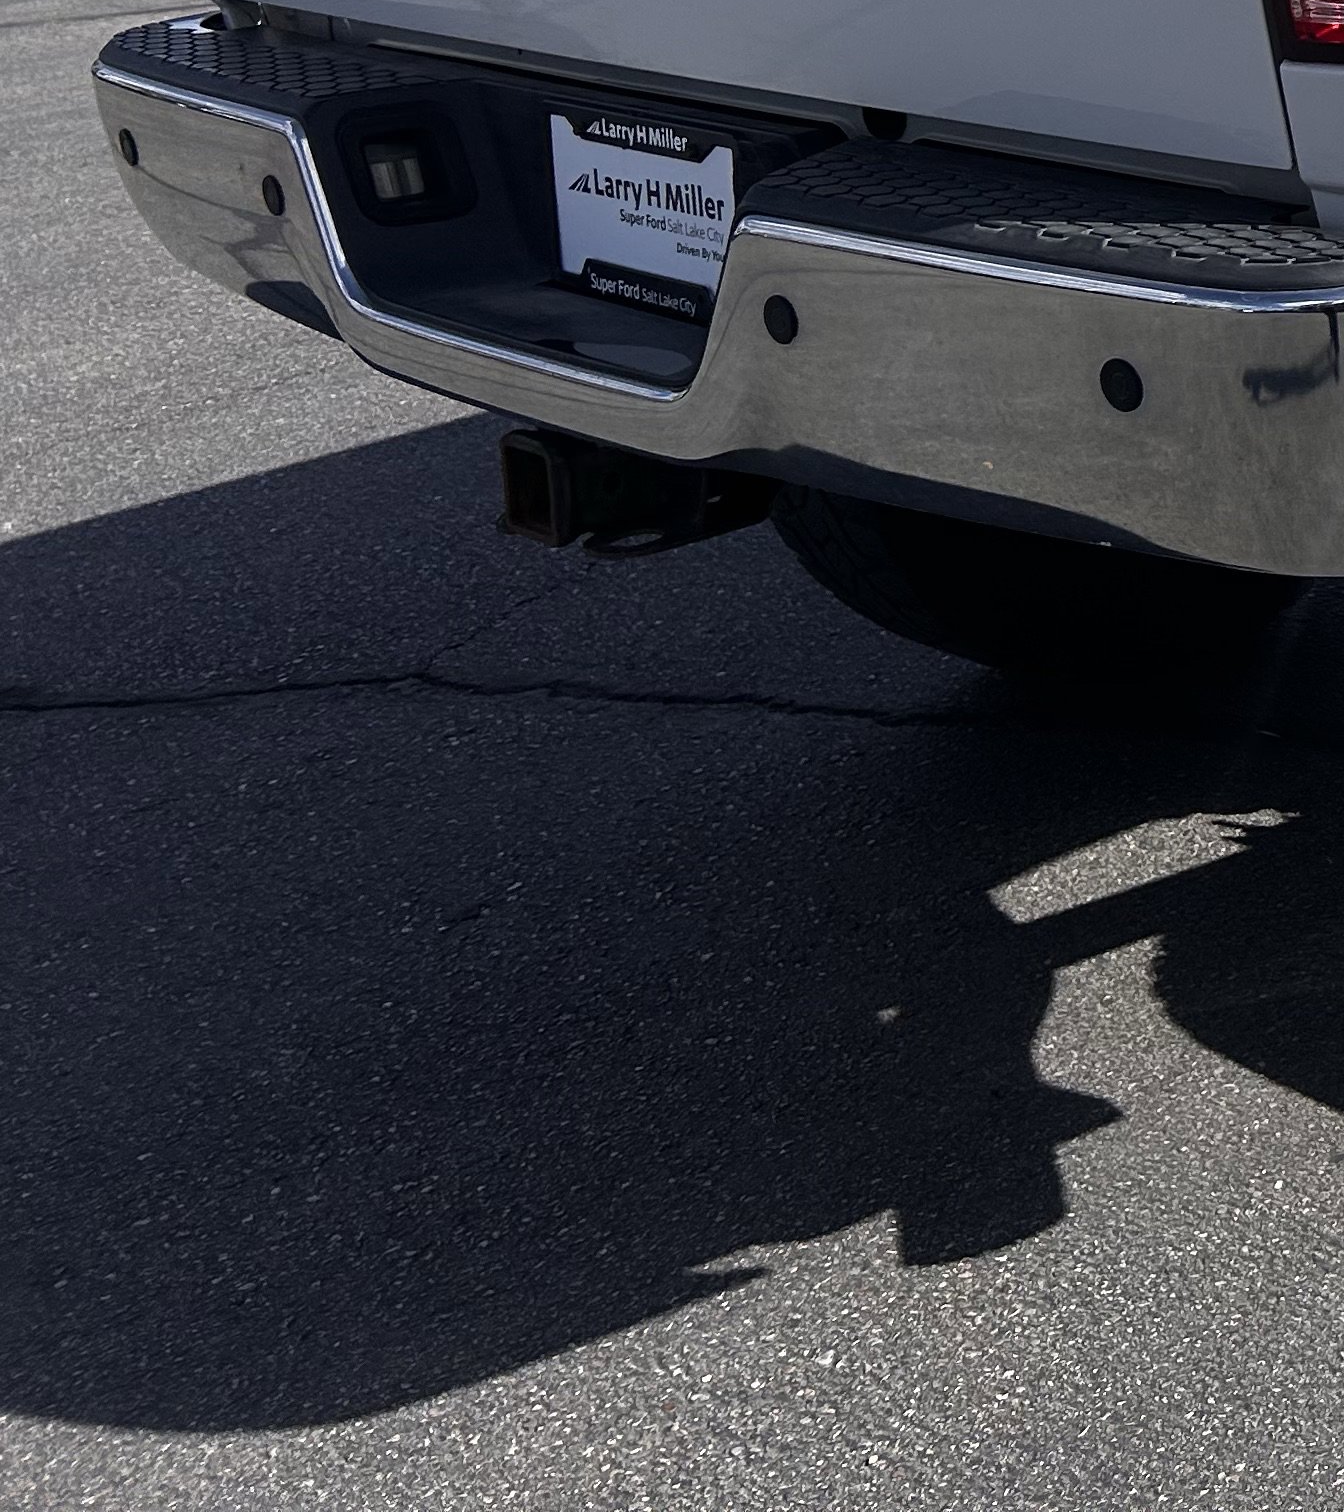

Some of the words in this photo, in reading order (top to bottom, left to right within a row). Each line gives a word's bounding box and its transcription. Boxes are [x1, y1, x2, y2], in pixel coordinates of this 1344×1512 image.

[602, 118, 635, 146] Larry
[637, 124, 647, 145] H
[649, 128, 688, 151] Miller
[593, 168, 642, 210] Larry
[646, 179, 661, 208] H
[665, 183, 725, 221] Miller
[620, 209, 644, 226] Super
[646, 214, 667, 232] Ford
[667, 218, 684, 236] Salt
[685, 222, 706, 240] Lake
[707, 227, 725, 246] City
[676, 242, 700, 257] Driven
[702, 247, 711, 262] By
[590, 272, 617, 295] Super
[618, 280, 640, 300] Ford
[642, 287, 658, 304] Salt
[659, 291, 679, 311] Lake
[680, 297, 697, 316] City
